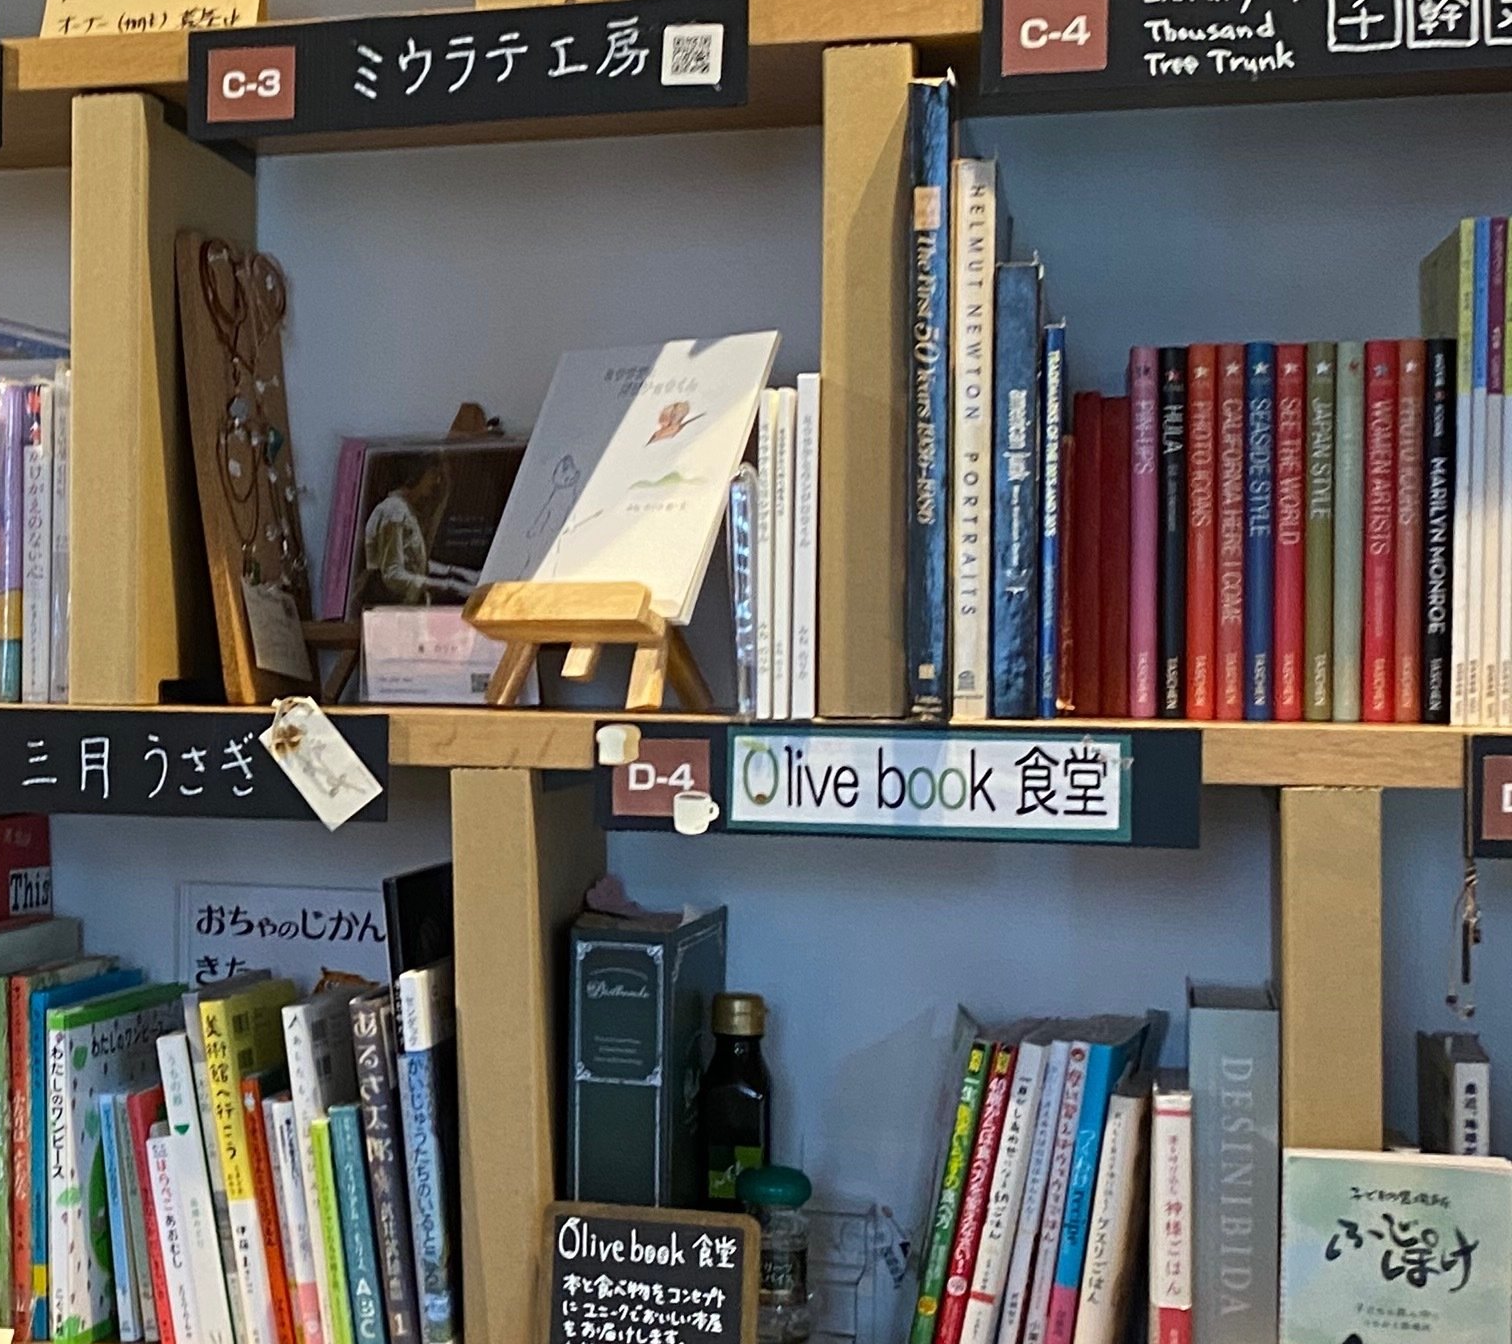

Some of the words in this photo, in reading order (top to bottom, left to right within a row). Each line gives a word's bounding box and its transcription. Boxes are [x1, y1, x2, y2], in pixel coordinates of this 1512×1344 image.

[354, 16, 650, 100] ミウラテ工房
[1019, 14, 1091, 49] C-4
[1144, 11, 1276, 43] Thousand
[222, 72, 281, 99] C-3
[969, 184, 986, 290] HELMUT
[913, 324, 940, 365] 50
[964, 304, 984, 421] NEWTON
[1162, 403, 1183, 455] HULA
[1252, 397, 1272, 479] SEASIDE
[1312, 397, 1333, 459] JAPAN
[1372, 399, 1395, 476] WOMEN
[1249, 483, 1270, 537] STYLE
[1280, 476, 1300, 546] WORLD
[1310, 462, 1331, 520] STYLE
[1370, 477, 1391, 556] ARTISTS
[1429, 456, 1448, 542] MARILYN
[960, 452, 979, 616] PORTRAITS
[1427, 546, 1446, 634] MONROE
[1165, 656, 1178, 710] TASCHEN
[1253, 653, 1266, 705] TASCHEN
[1314, 653, 1327, 707] TASCHEN
[1428, 657, 1442, 711] TASCHEN
[628, 763, 694, 791] D-4
[742, 739, 860, 810] Olive
[877, 746, 996, 812] book
[1014, 744, 1108, 818] 食堂
[196, 903, 387, 944] おちゃのじかん
[50, 1047, 65, 1178] わたしのワンピース
[204, 1012, 238, 1161] 美術館へ行こう
[155, 1158, 184, 1271] はらぺこあおむし
[1219, 1056, 1252, 1317] DESINIBIDA
[558, 1217, 625, 1263] Olive
[630, 1228, 686, 1267] book
[692, 1233, 738, 1269] 食堂
